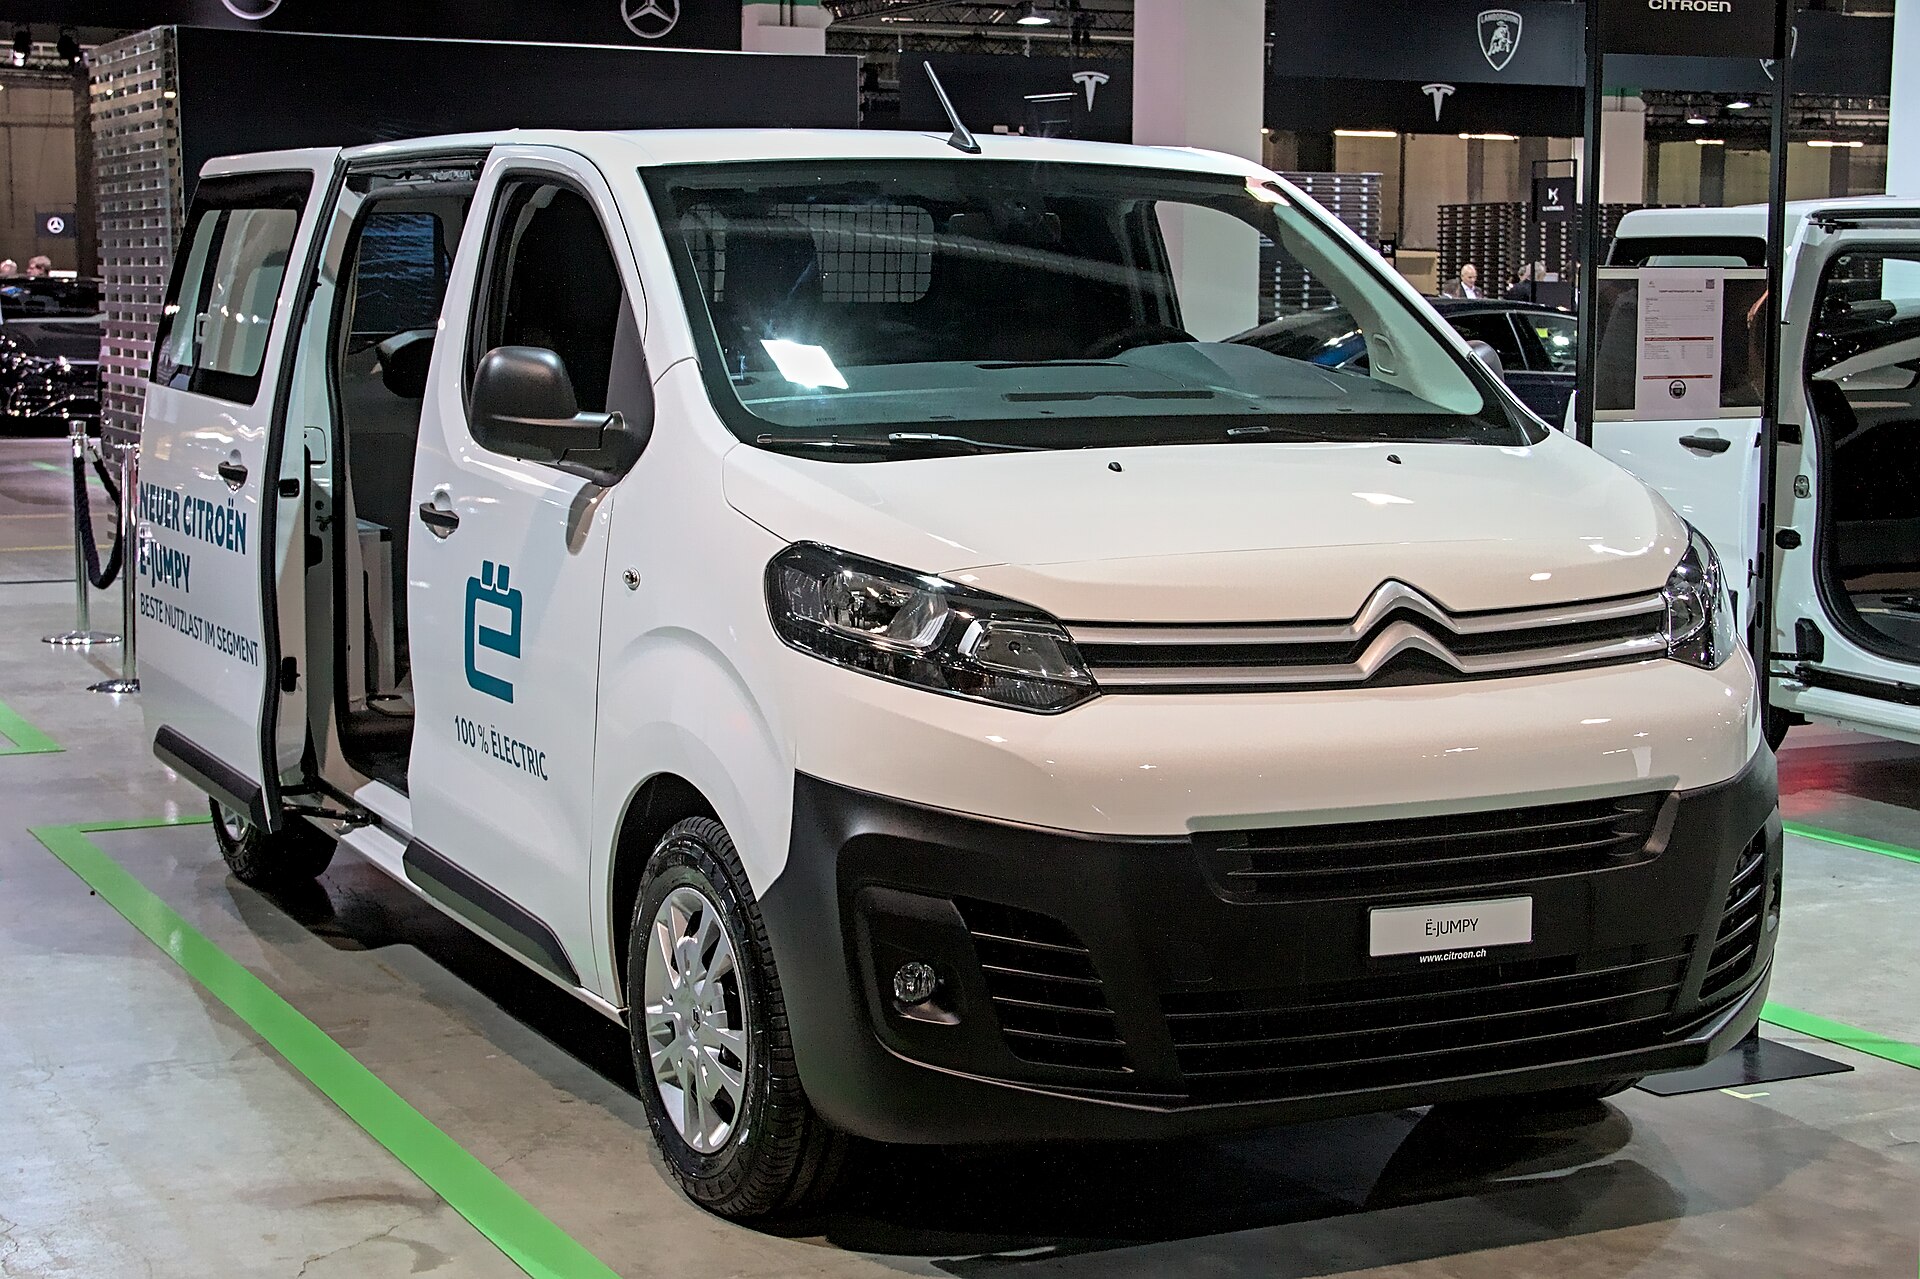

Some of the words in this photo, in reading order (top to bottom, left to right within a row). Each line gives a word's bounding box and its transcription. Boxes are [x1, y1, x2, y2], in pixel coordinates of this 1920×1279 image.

[140, 480, 180, 532] NEUER
[183, 497, 247, 555] CITROËN
[140, 592, 164, 624] BESTE
[164, 604, 203, 642] NUTZLAST
[204, 620, 216, 645] IM
[217, 627, 259, 667] SEGMENT
[455, 715, 476, 748] 100
[478, 724, 489, 755] %
[490, 724, 549, 782] ËLECTRIC
[1418, 949, 1486, 963] www.citroen.ch
[1425, 918, 1479, 938] Ë-JUMPY
